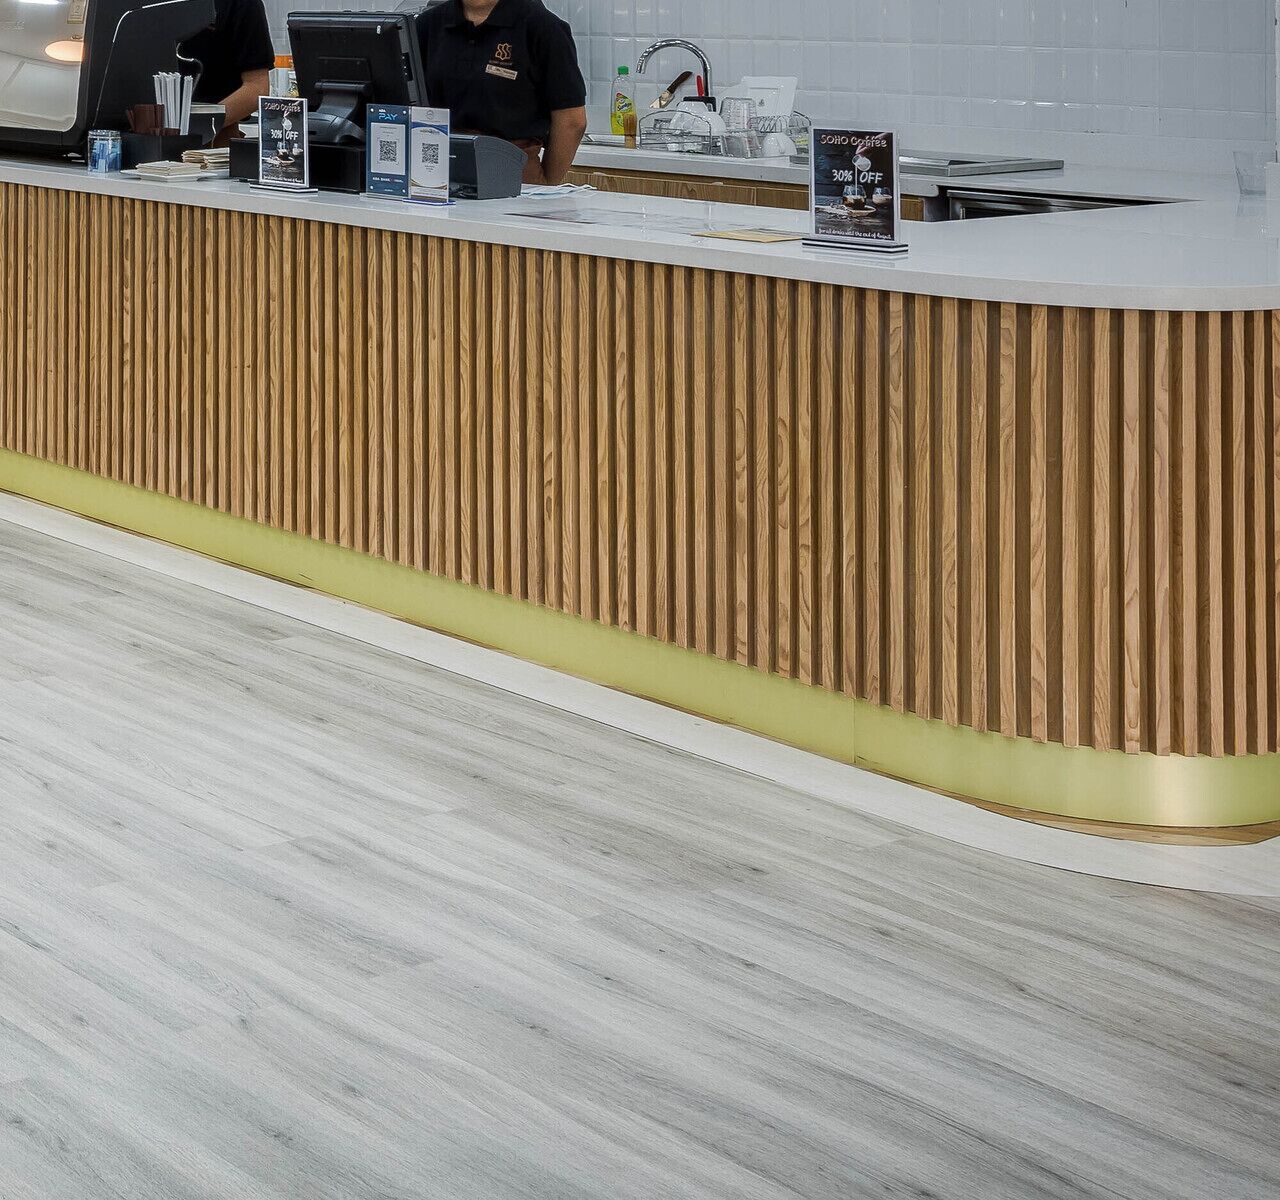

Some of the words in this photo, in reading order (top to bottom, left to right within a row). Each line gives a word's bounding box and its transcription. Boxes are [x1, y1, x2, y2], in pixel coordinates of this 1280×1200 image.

[379, 112, 398, 120] PAY
[270, 129, 283, 139] 30%
[285, 131, 299, 141] OFF
[820, 134, 849, 145] SOHO
[851, 136, 887, 148] Coffee
[831, 169, 853, 182] 30%
[860, 171, 883, 184] OFF
